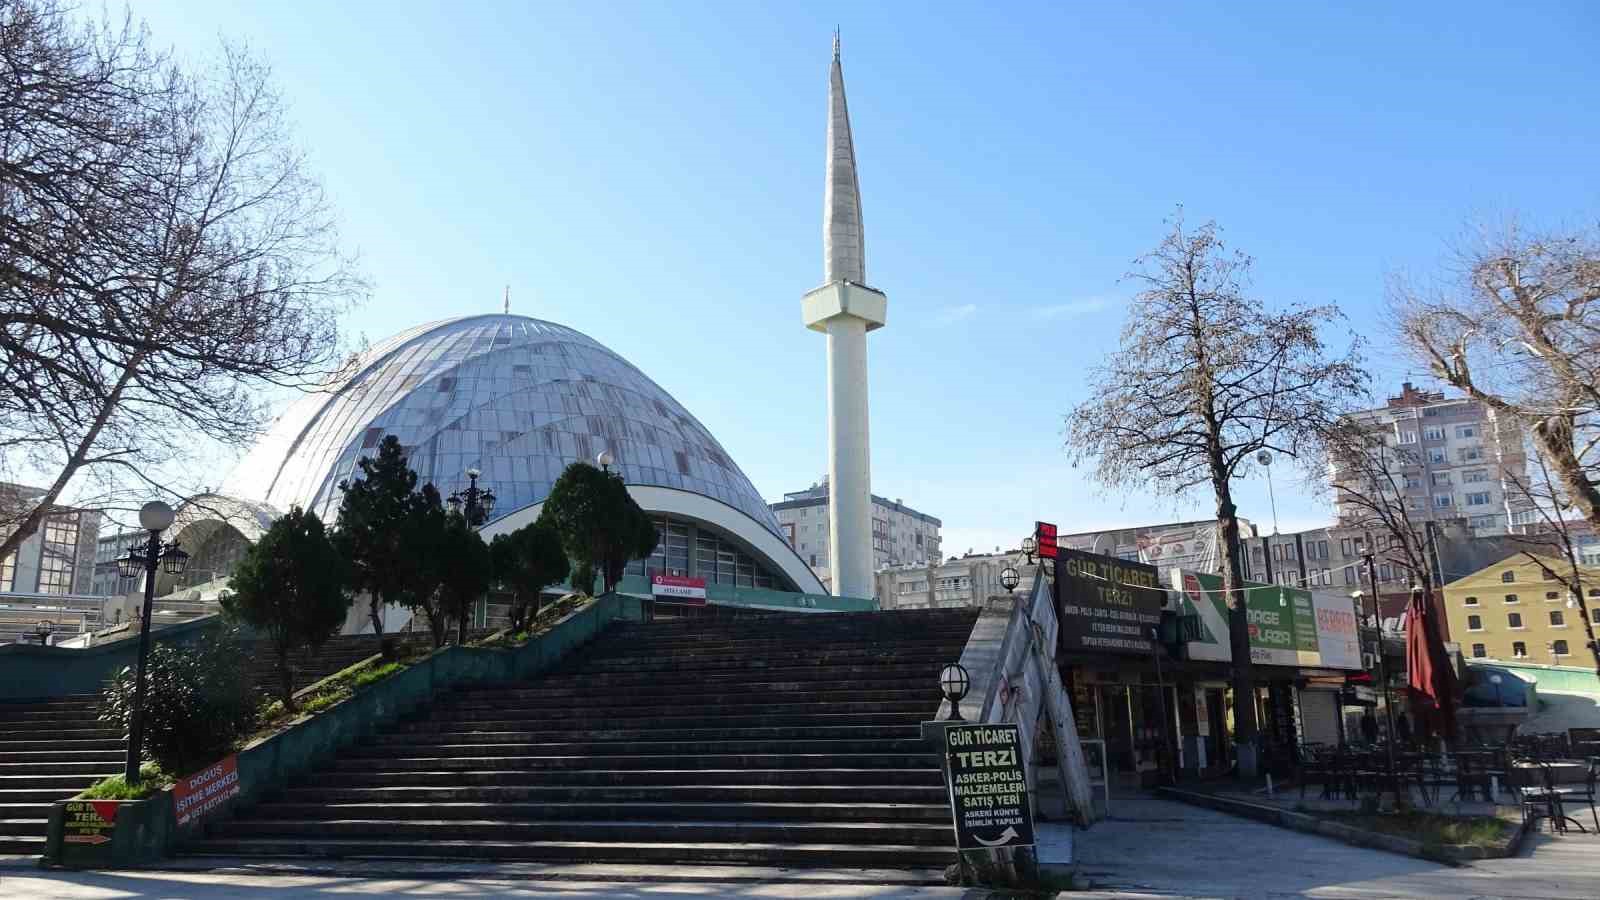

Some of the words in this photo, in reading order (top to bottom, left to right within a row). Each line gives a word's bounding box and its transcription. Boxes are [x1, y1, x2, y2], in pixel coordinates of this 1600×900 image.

[949, 728, 973, 746] GÜR
[974, 727, 1017, 745] TİCARET
[957, 746, 1017, 768] TERZİ
[955, 769, 1022, 784] ASKER-POLİS
[955, 781, 1026, 796] MALZEMELERİ
[964, 796, 993, 808] SATIŞ
[995, 792, 1020, 805] YERİ
